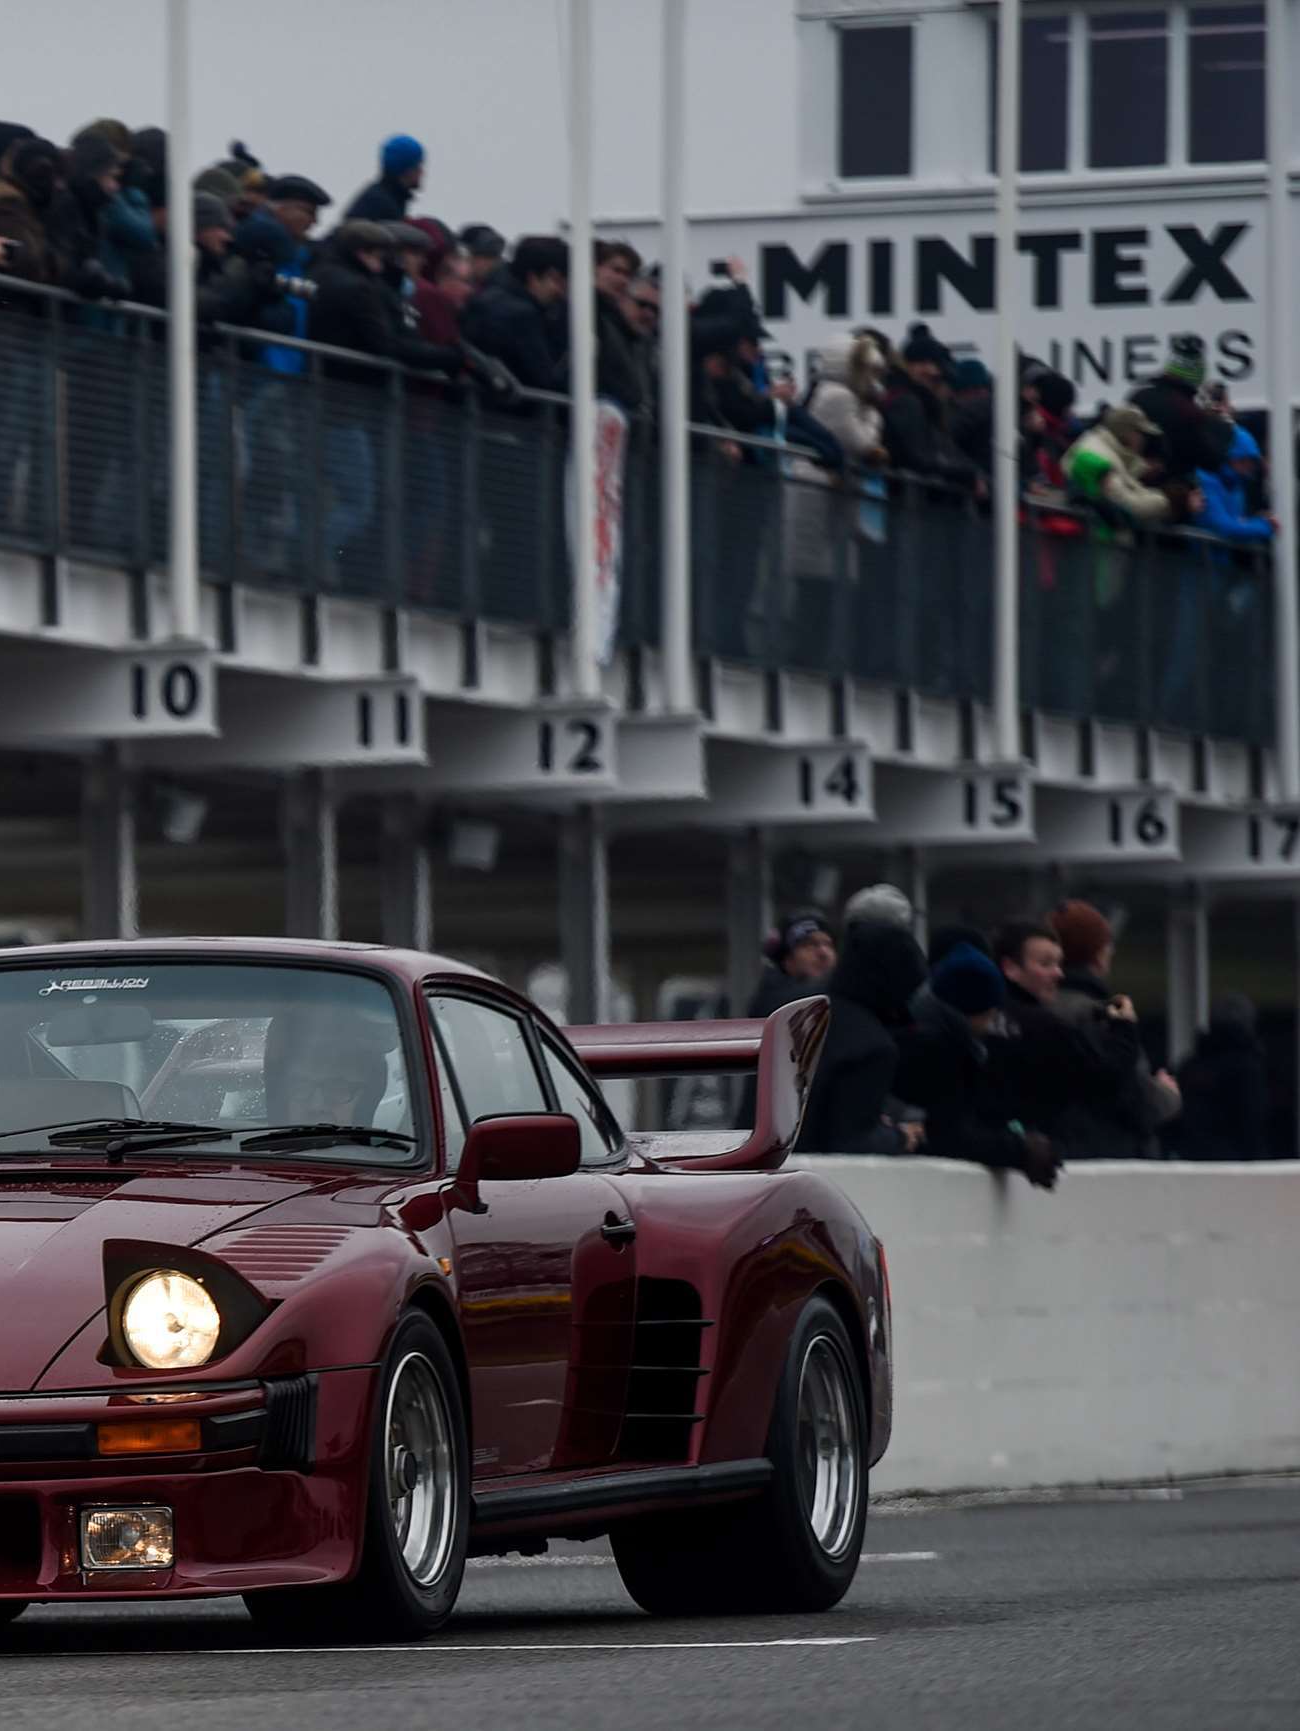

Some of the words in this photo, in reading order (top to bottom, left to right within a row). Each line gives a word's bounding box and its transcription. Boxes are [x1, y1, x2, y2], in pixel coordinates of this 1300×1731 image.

[759, 222, 1254, 319] MINTEX
[131, 663, 199, 718] 10
[358, 692, 410, 747] 11
[539, 720, 602, 772] 12
[799, 755, 860, 808] 14
[965, 778, 1022, 828] 15
[1108, 802, 1165, 848] 16
[1249, 814, 1300, 862] 17
